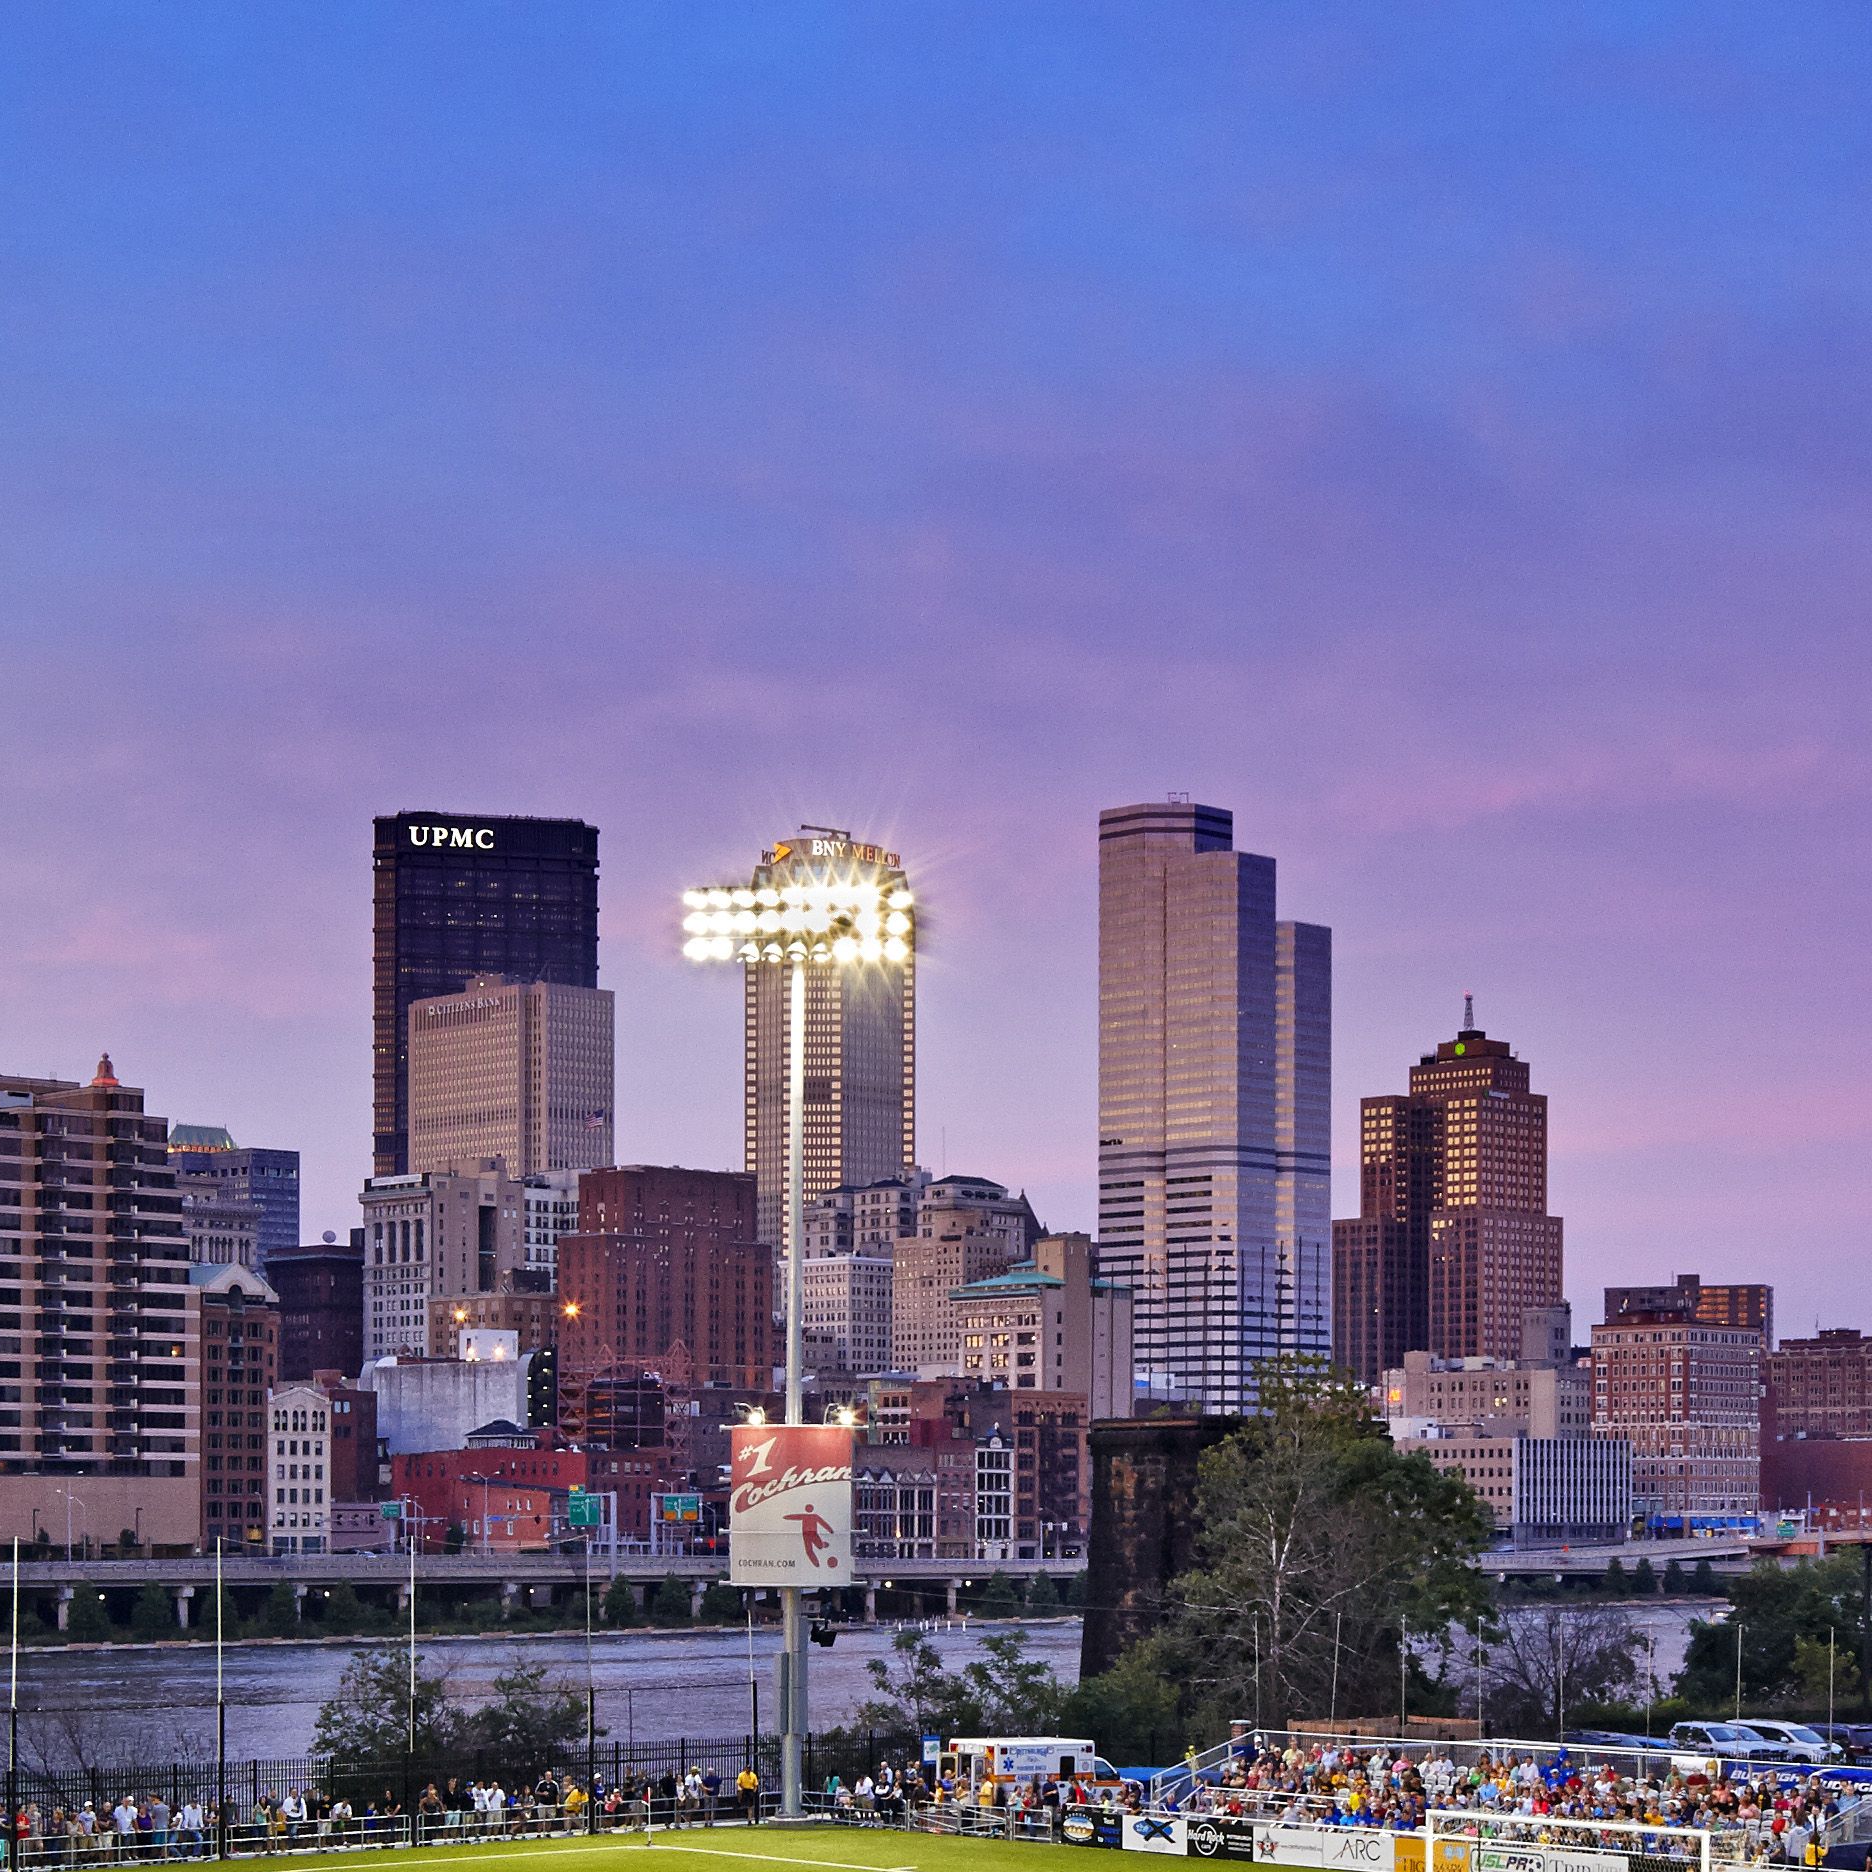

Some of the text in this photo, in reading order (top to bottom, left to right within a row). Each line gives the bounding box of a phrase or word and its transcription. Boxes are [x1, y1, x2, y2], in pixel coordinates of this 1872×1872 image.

[409, 826, 494, 849] UPMC
[813, 840, 847, 858] BNY
[437, 997, 500, 1015] CITIZENS BANK
[738, 1437, 777, 1478] #1
[733, 1466, 851, 1511] Cochran
[738, 1559, 796, 1568] COCHRAN.COM
[1187, 1829, 1225, 1845] Hard Rock
[1333, 1838, 1381, 1861] ARC
